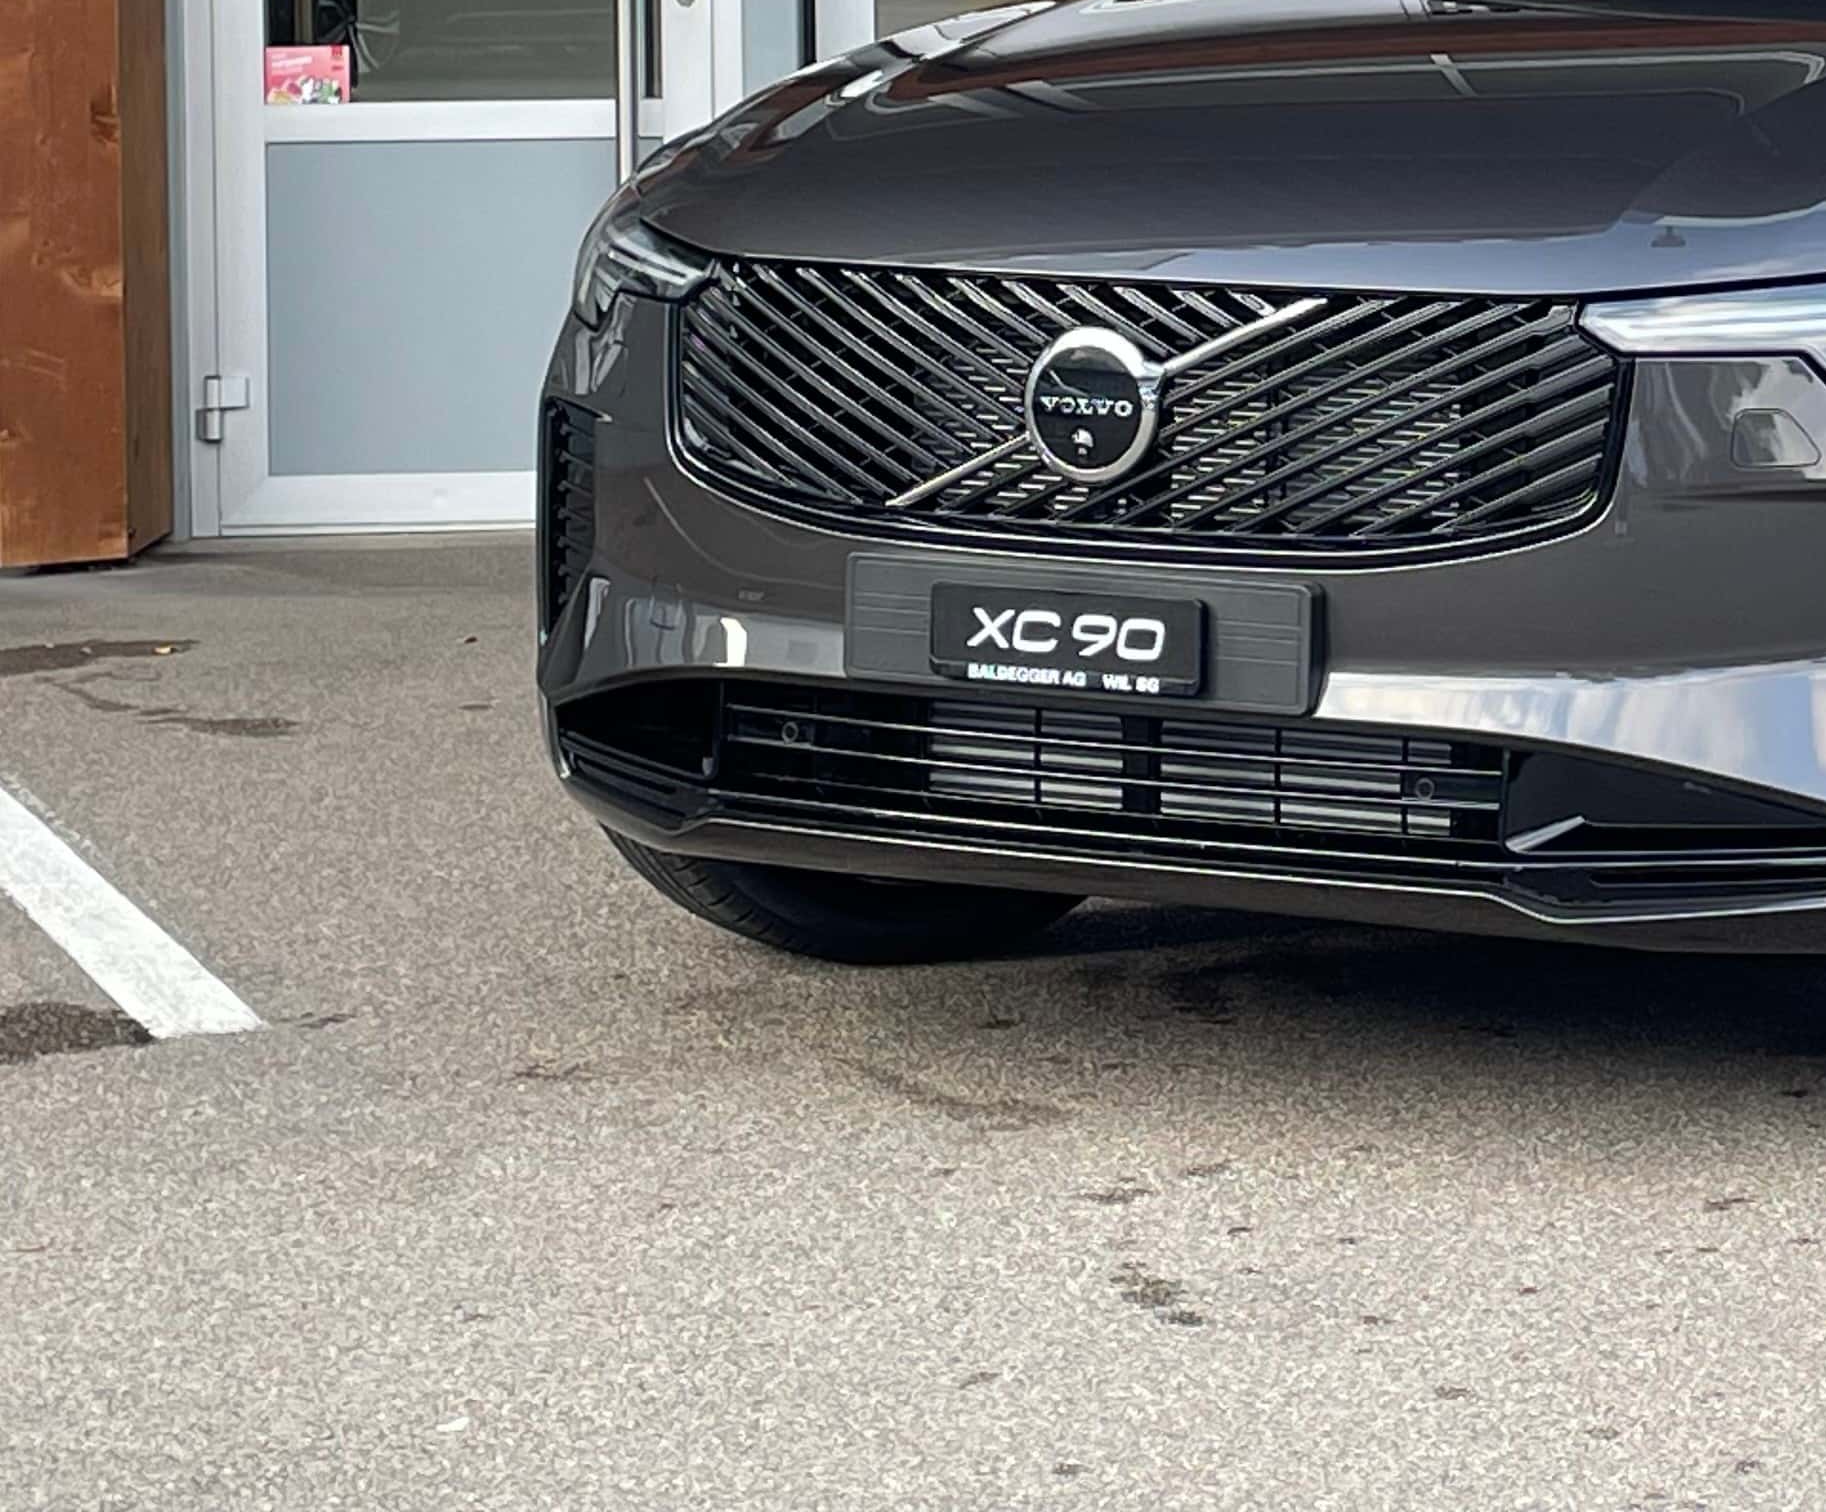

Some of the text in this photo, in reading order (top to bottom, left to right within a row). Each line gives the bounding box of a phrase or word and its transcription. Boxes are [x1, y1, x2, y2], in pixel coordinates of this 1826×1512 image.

[1039, 395, 1134, 417] VOLVO
[966, 607, 1166, 661] XC 90
[967, 662, 1060, 685] BALDEGGER
[1062, 670, 1087, 687] AG
